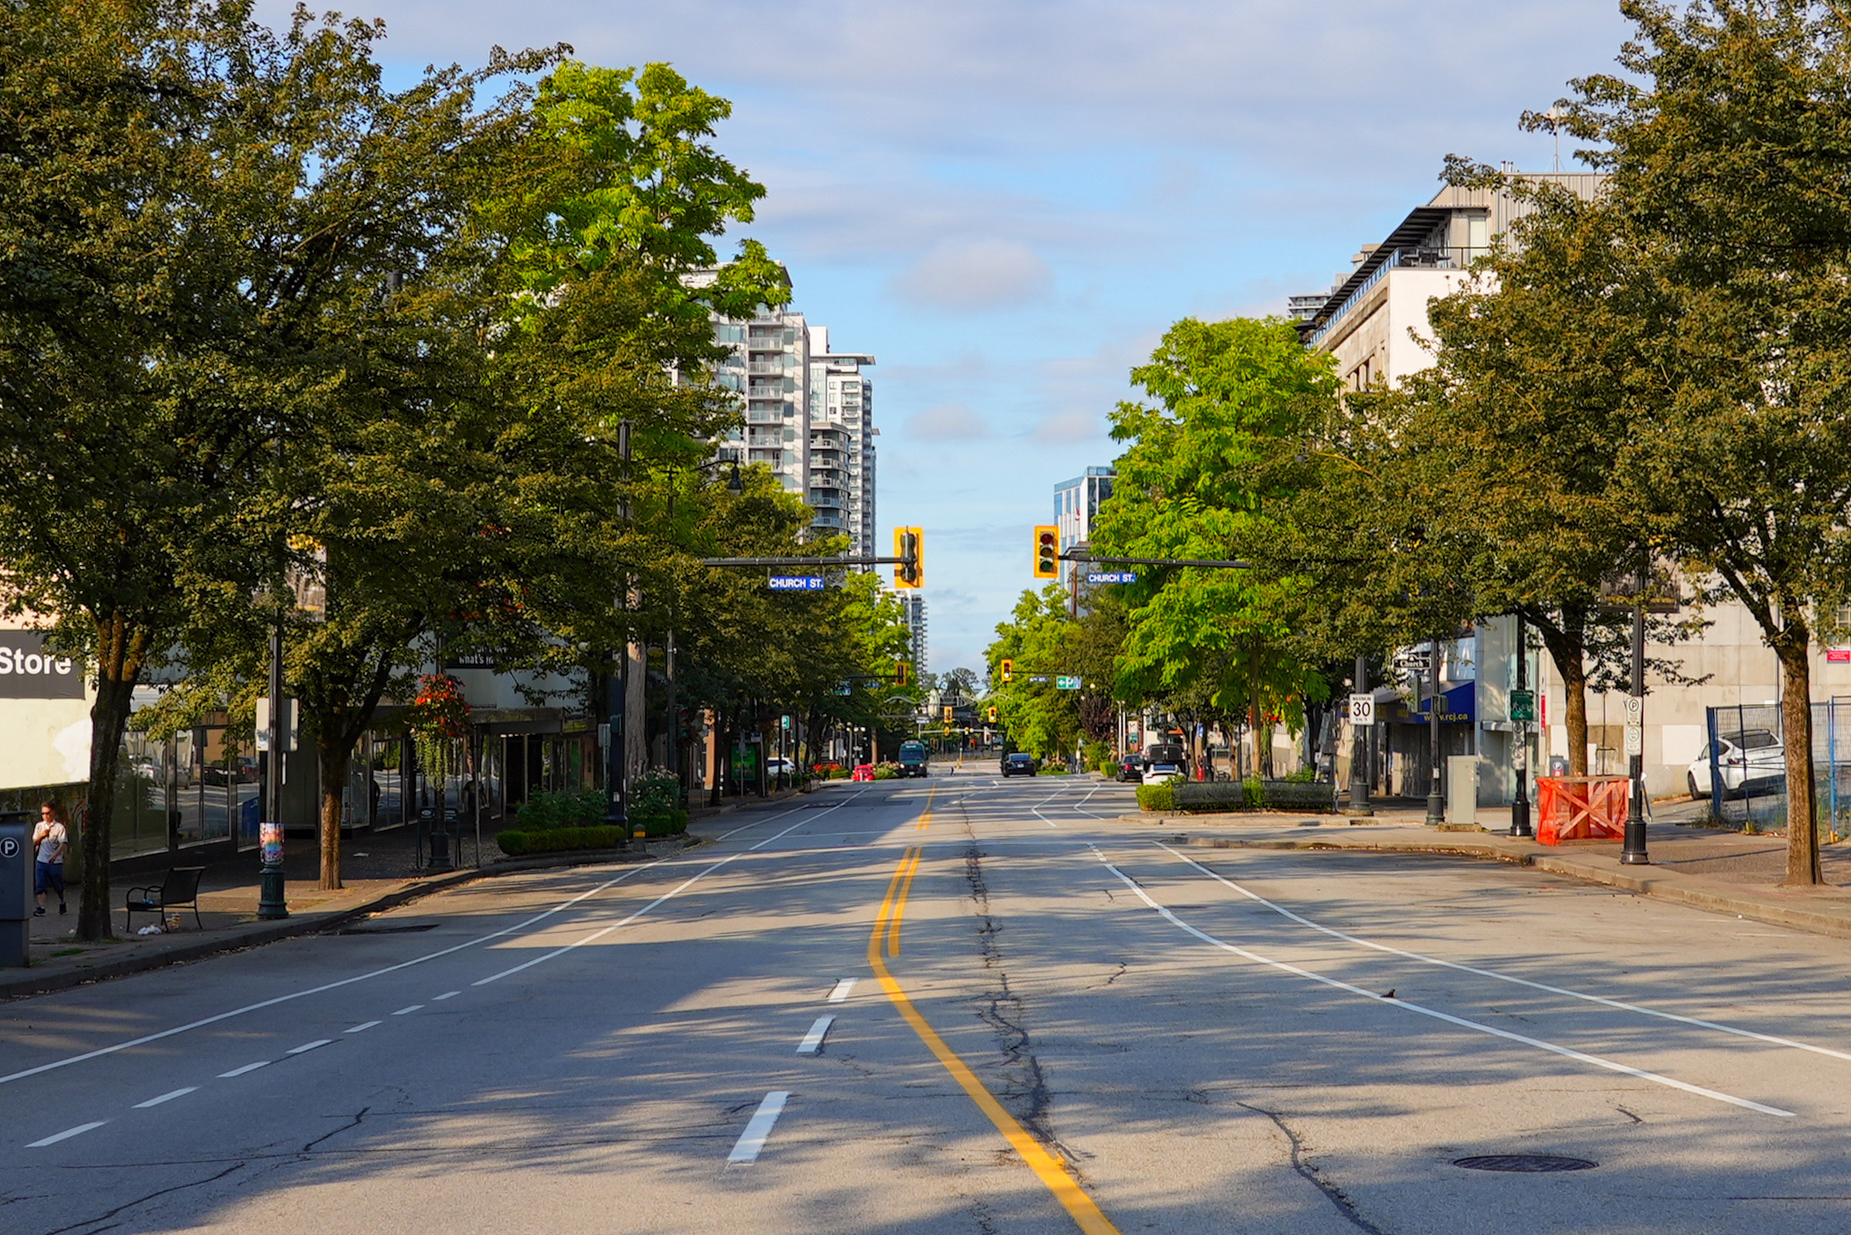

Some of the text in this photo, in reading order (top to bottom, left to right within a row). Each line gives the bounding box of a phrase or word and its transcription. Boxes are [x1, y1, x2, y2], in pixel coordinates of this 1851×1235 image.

[769, 578, 824, 588] CHURCH ST.
[1088, 573, 1135, 583] CHURCH ST.
[0, 646, 72, 675] Store
[1400, 659, 1424, 669] Church
[1353, 701, 1371, 717] 30
